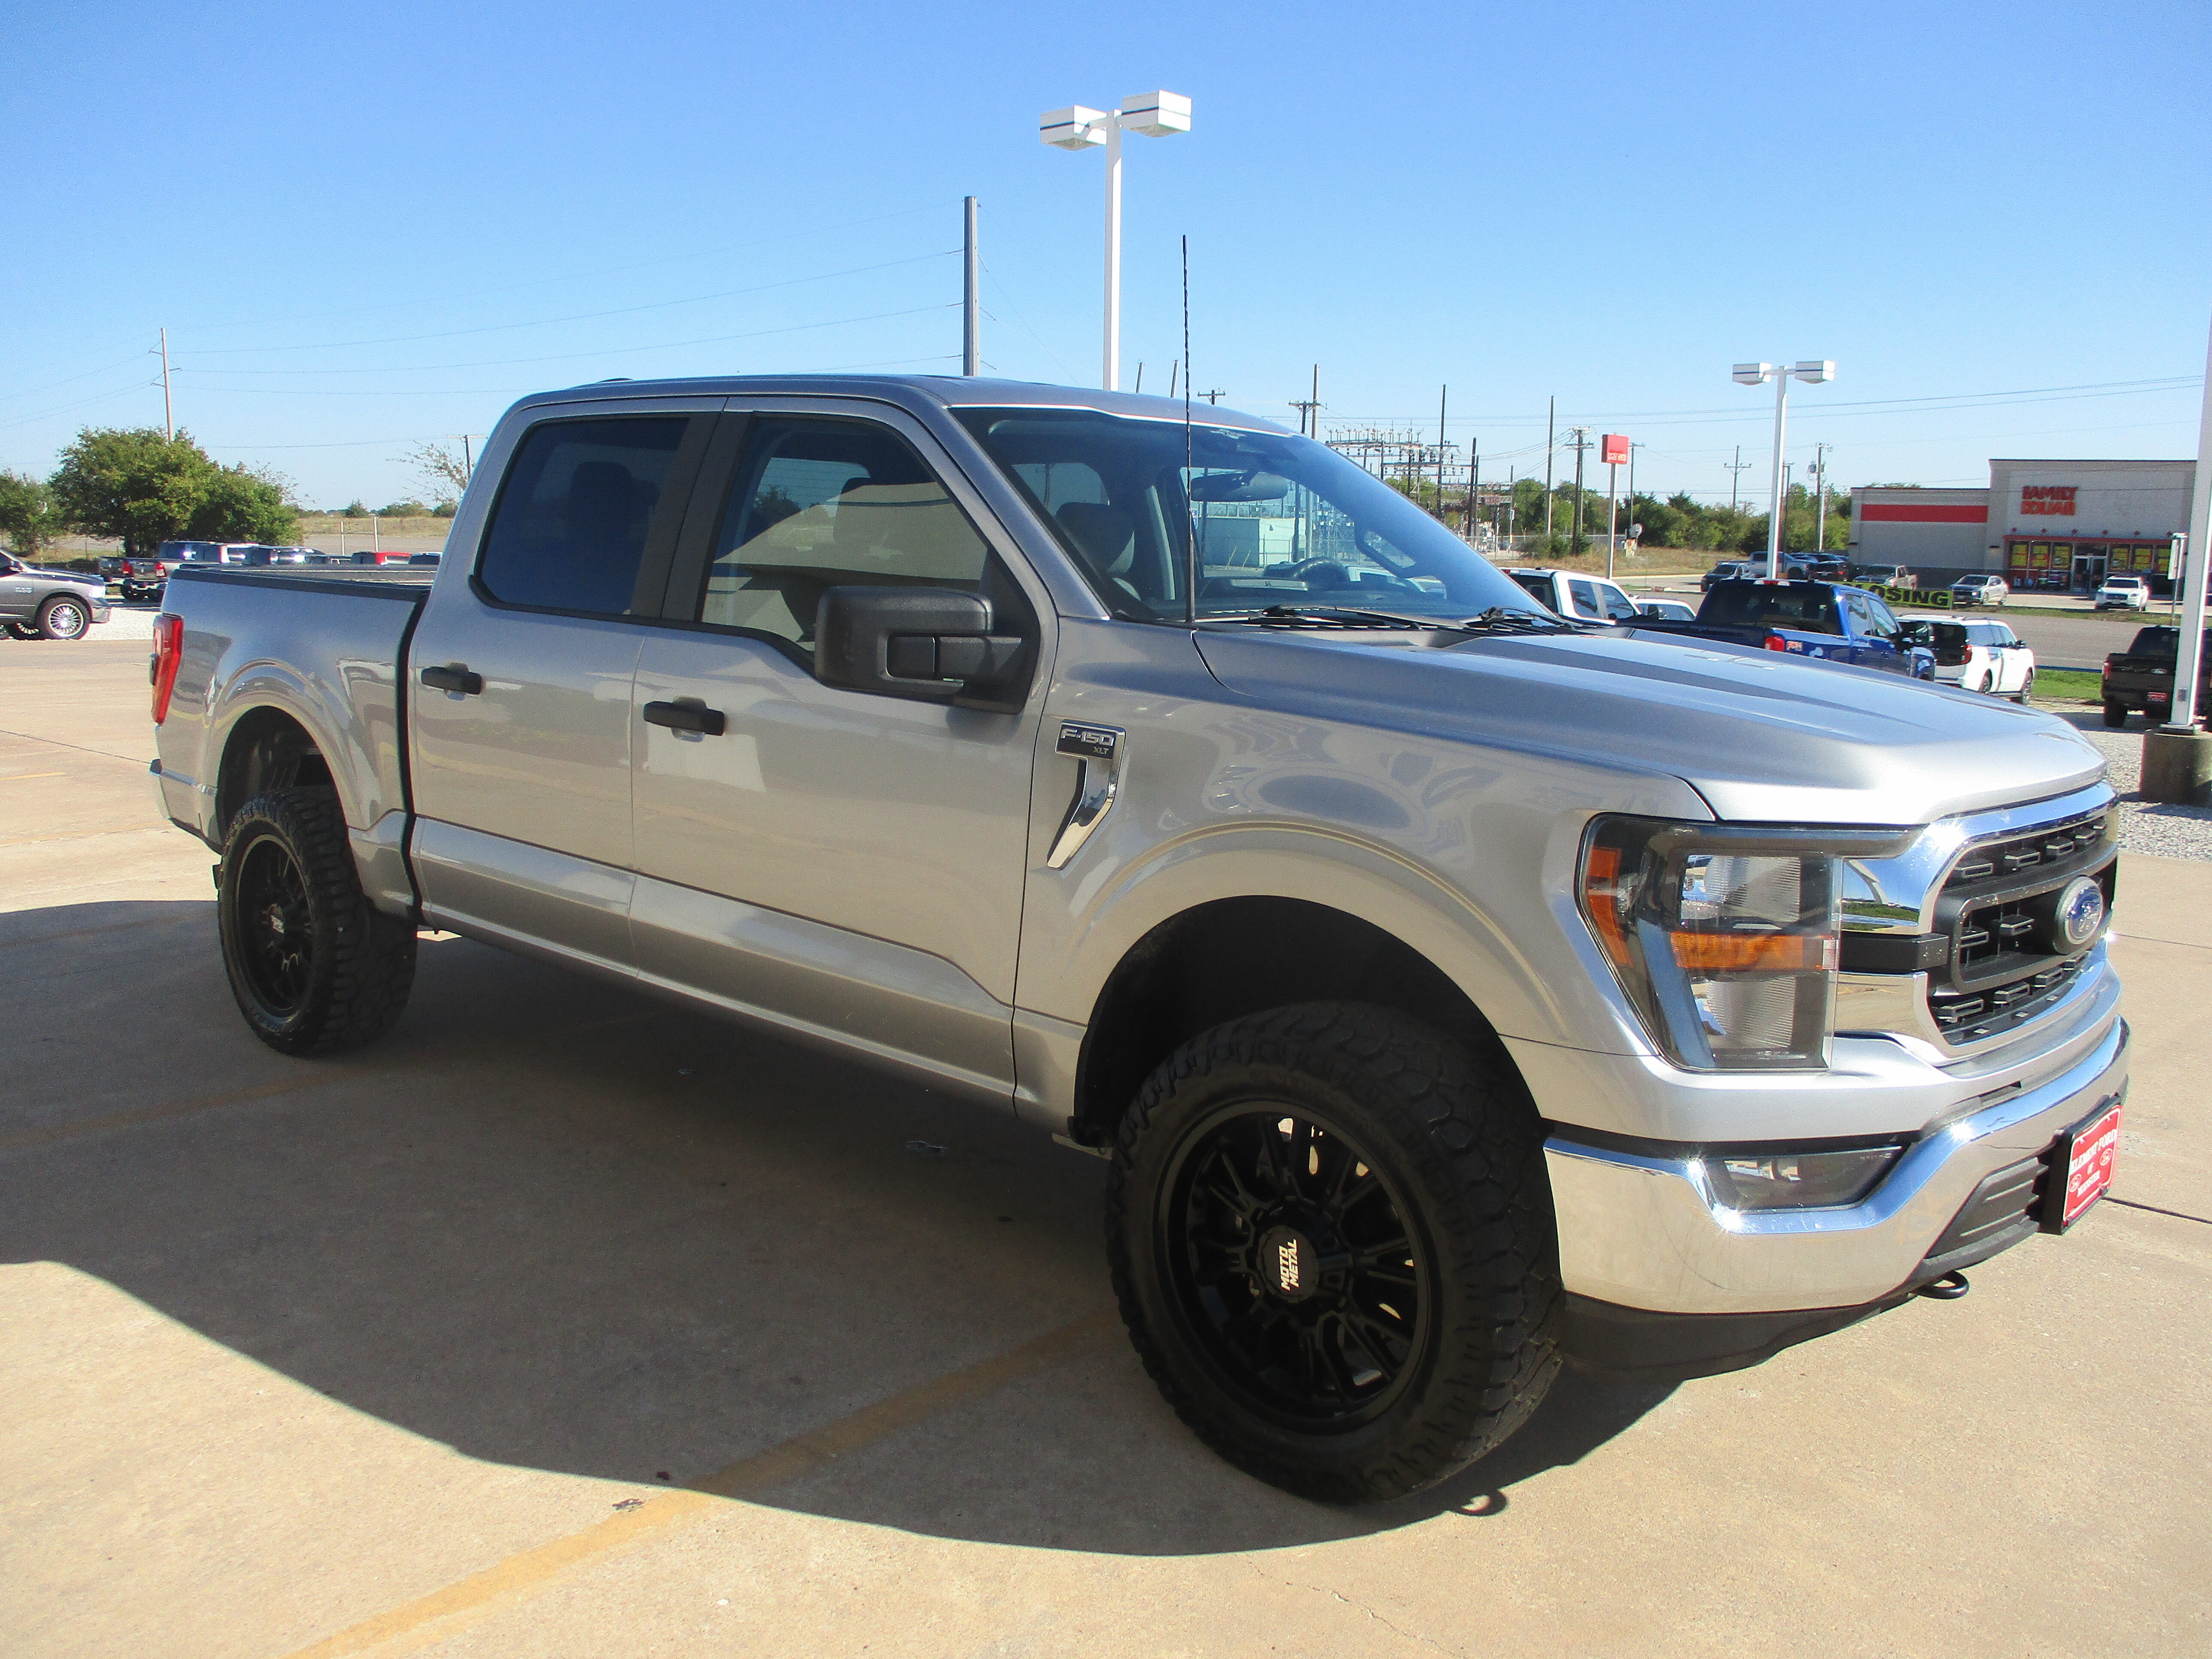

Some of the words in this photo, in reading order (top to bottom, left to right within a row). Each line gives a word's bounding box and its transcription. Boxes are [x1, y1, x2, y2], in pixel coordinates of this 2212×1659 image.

[2022, 486, 2078, 500] FAMILY
[2021, 501, 2075, 515] DOLLAR
[1842, 583, 1948, 606] OSING
[1060, 727, 1115, 746] F-150
[1093, 746, 1109, 754] XLT
[1279, 1245, 1291, 1291] MOTO
[1287, 1238, 1300, 1288] METAL
